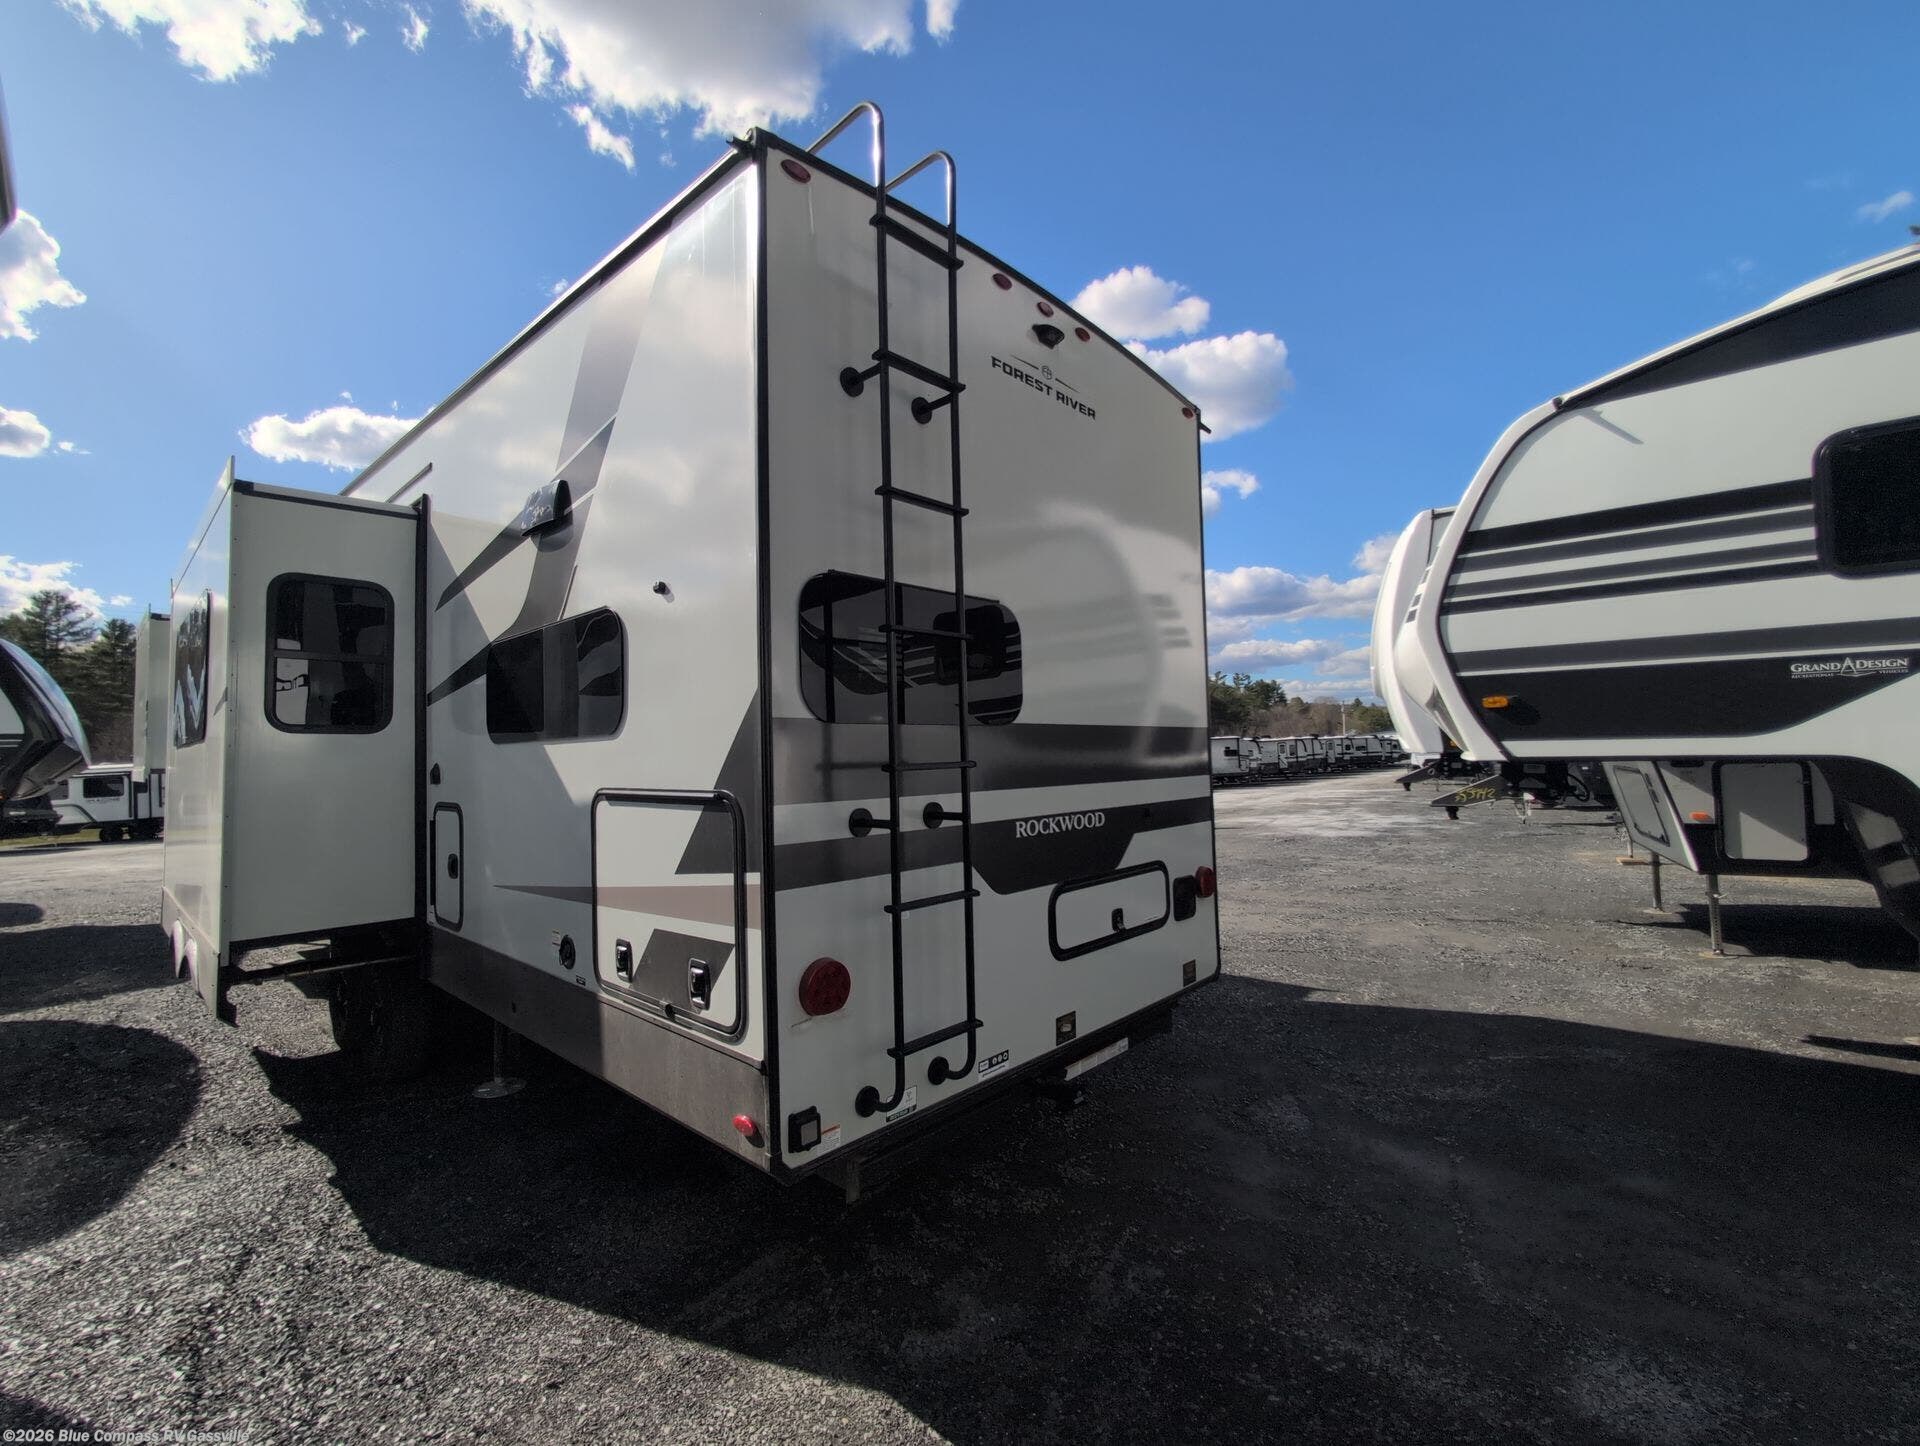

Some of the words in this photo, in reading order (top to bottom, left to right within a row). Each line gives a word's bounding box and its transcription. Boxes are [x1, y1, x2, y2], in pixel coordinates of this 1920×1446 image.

[991, 355, 1053, 396] FOREST
[1055, 389, 1096, 420] RIVER
[1015, 811, 1106, 838] ROCKWOOD
